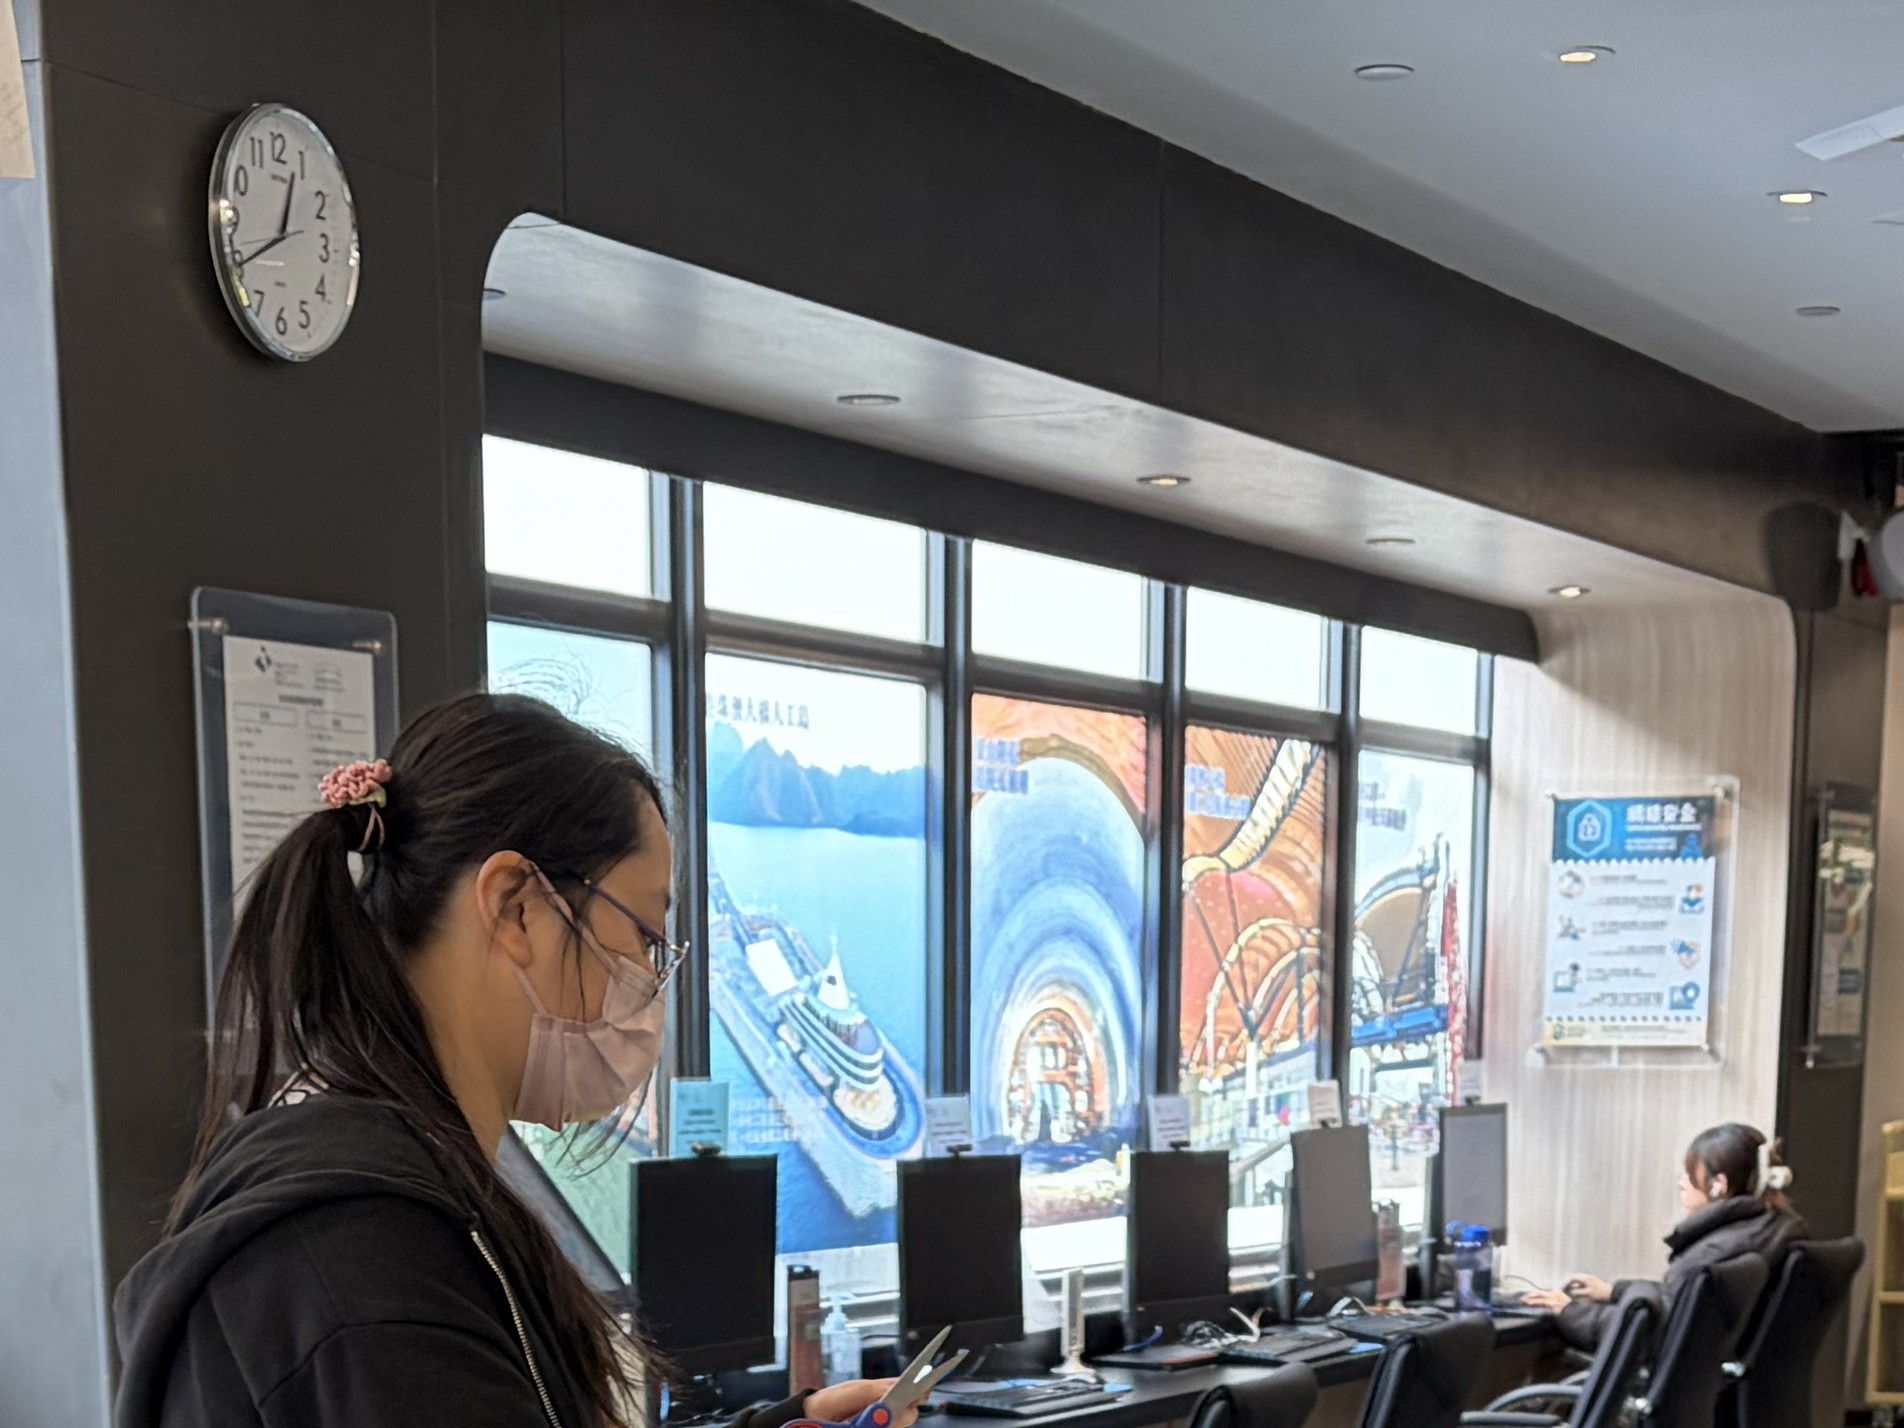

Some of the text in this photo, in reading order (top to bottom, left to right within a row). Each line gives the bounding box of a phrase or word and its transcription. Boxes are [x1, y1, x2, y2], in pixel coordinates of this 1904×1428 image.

[315, 190, 329, 220] 2
[318, 233, 330, 263] 3
[315, 274, 327, 298] 4
[275, 307, 287, 336] 6
[299, 301, 311, 329] 5
